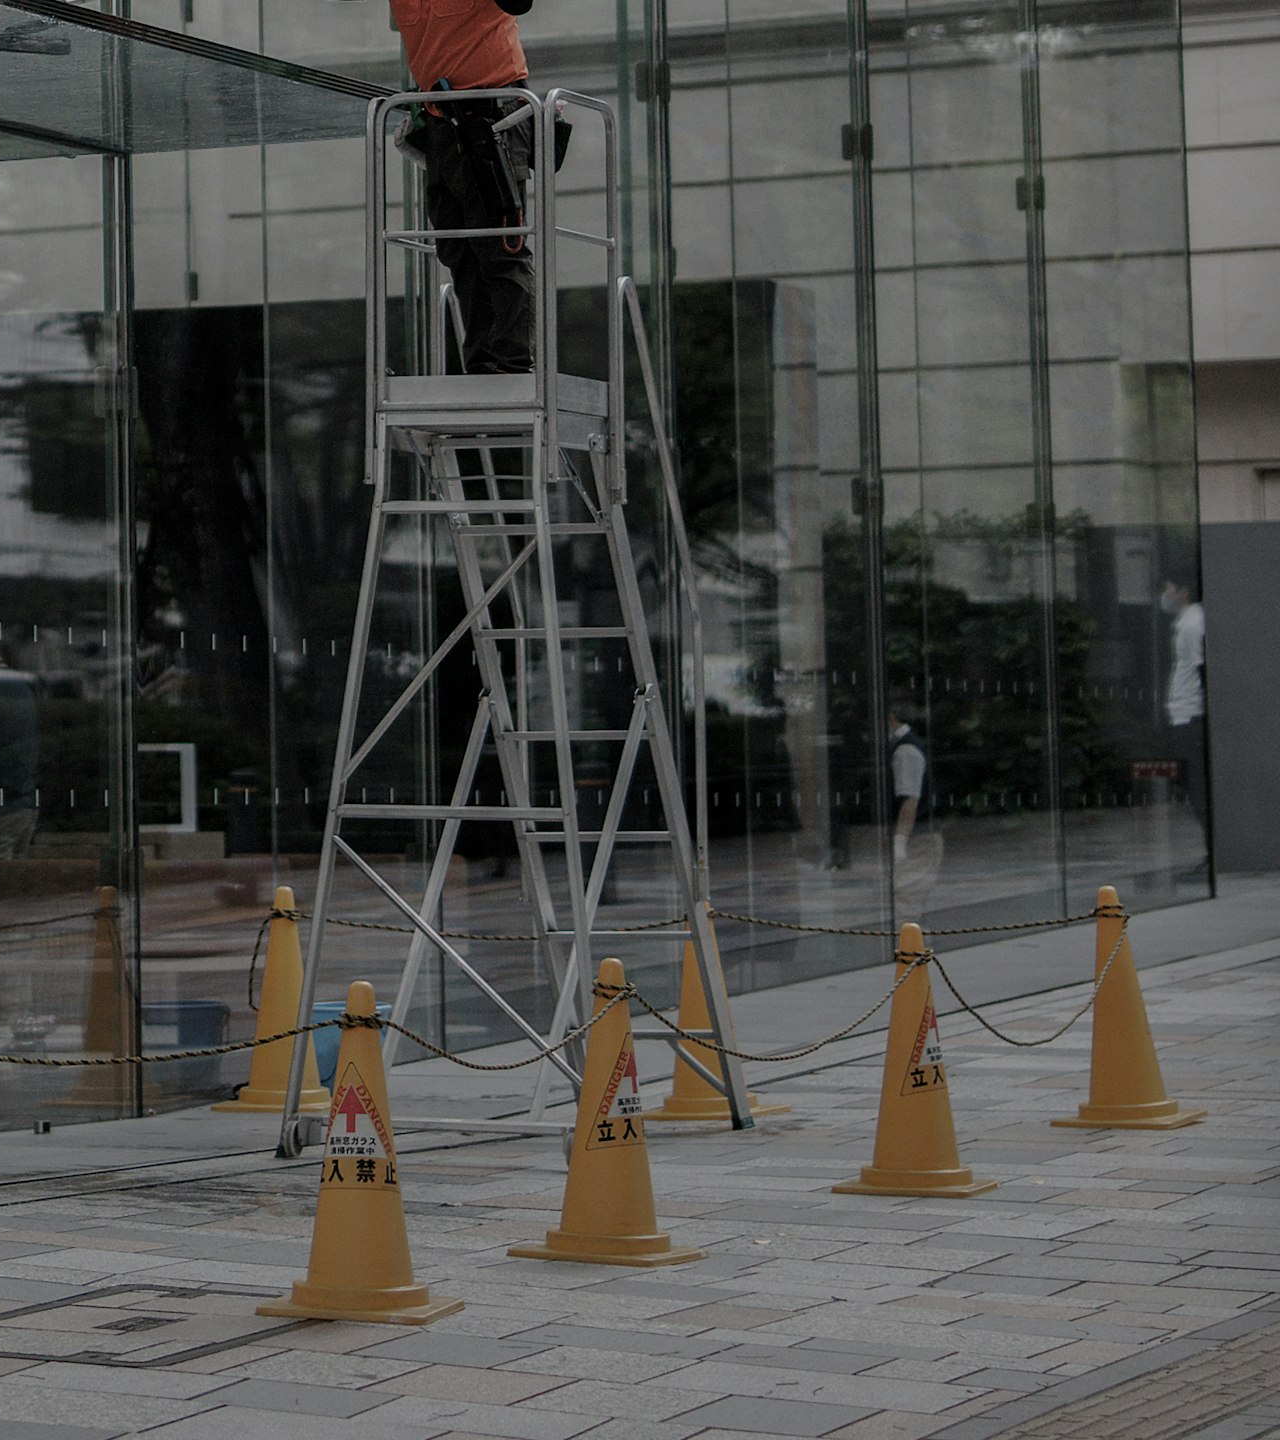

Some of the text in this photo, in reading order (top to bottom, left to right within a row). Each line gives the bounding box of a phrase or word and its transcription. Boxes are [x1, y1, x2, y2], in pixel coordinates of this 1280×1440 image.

[600, 1051, 628, 1115] DANGER
[356, 1085, 392, 1152] DANGER
[597, 1119, 645, 1142] 立入
[320, 1159, 397, 1185] 入禁止
